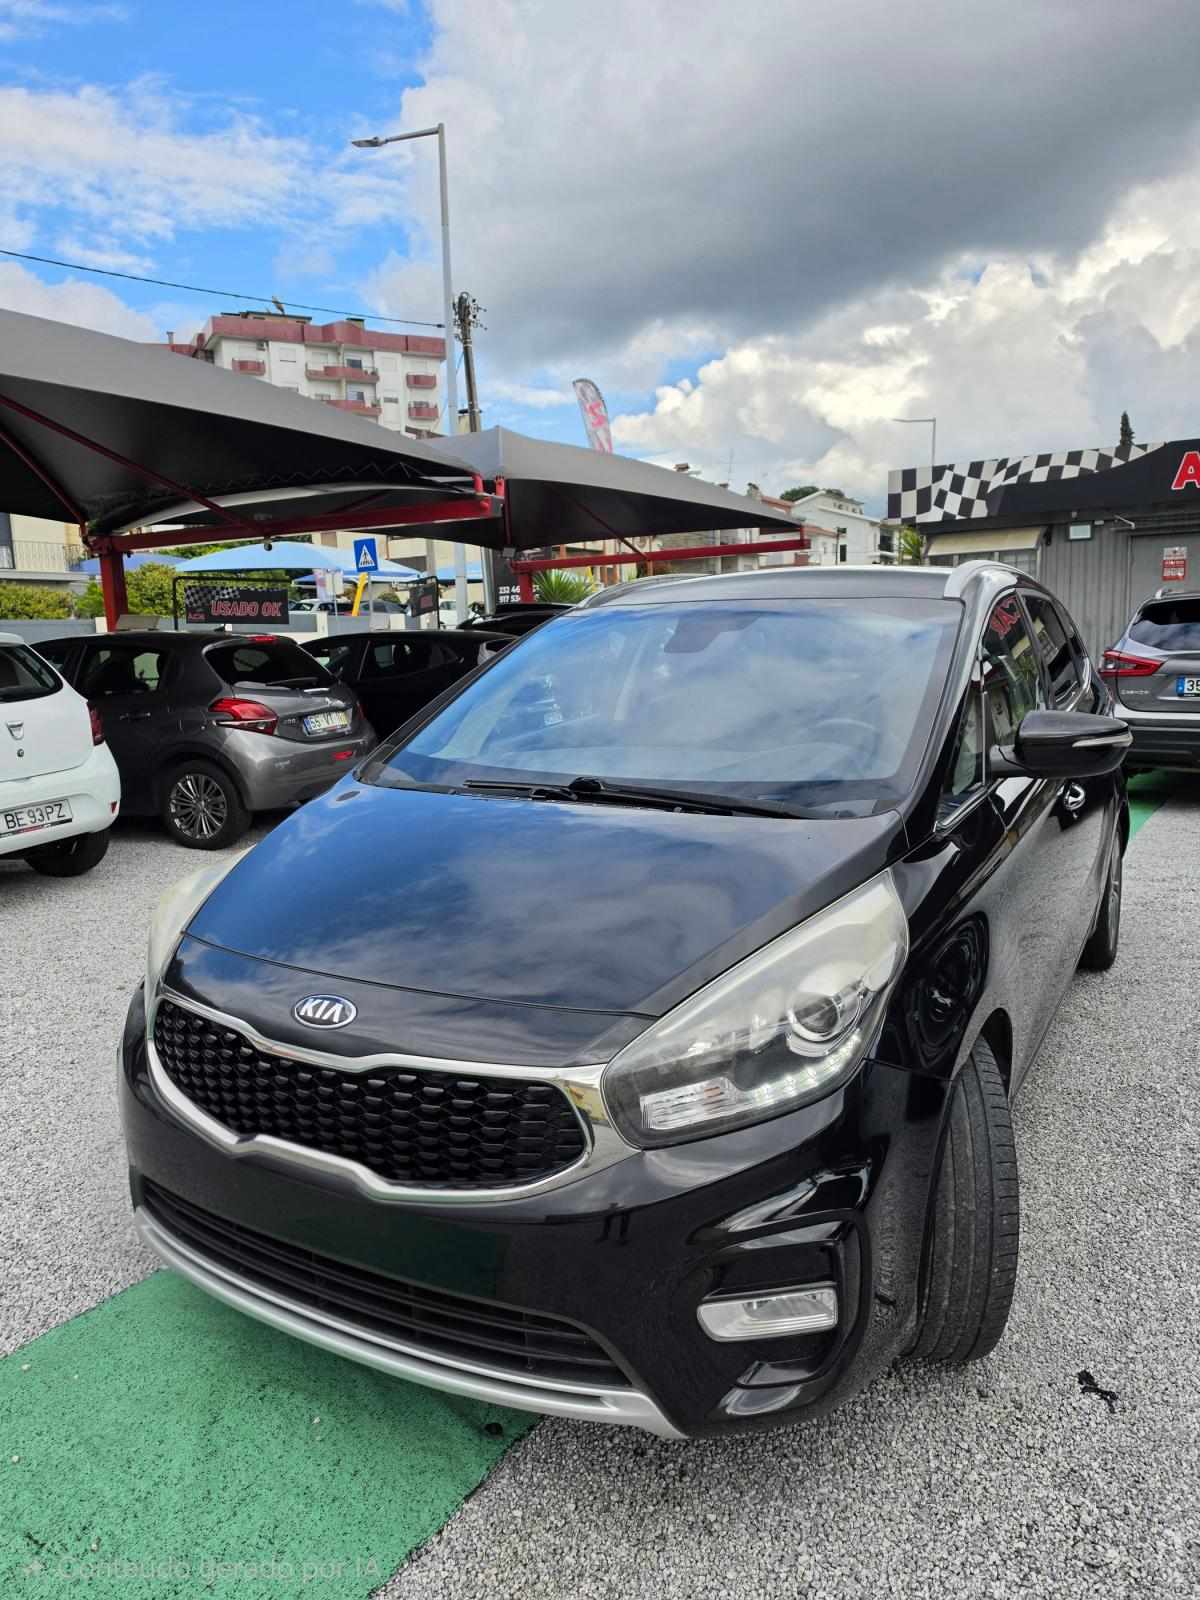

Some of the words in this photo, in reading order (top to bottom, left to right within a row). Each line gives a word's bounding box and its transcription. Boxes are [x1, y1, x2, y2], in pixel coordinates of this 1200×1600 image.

[1170, 450, 1200, 490] A
[211, 601, 259, 617] USADO
[261, 602, 283, 617] OK
[299, 998, 343, 1023] KIA
